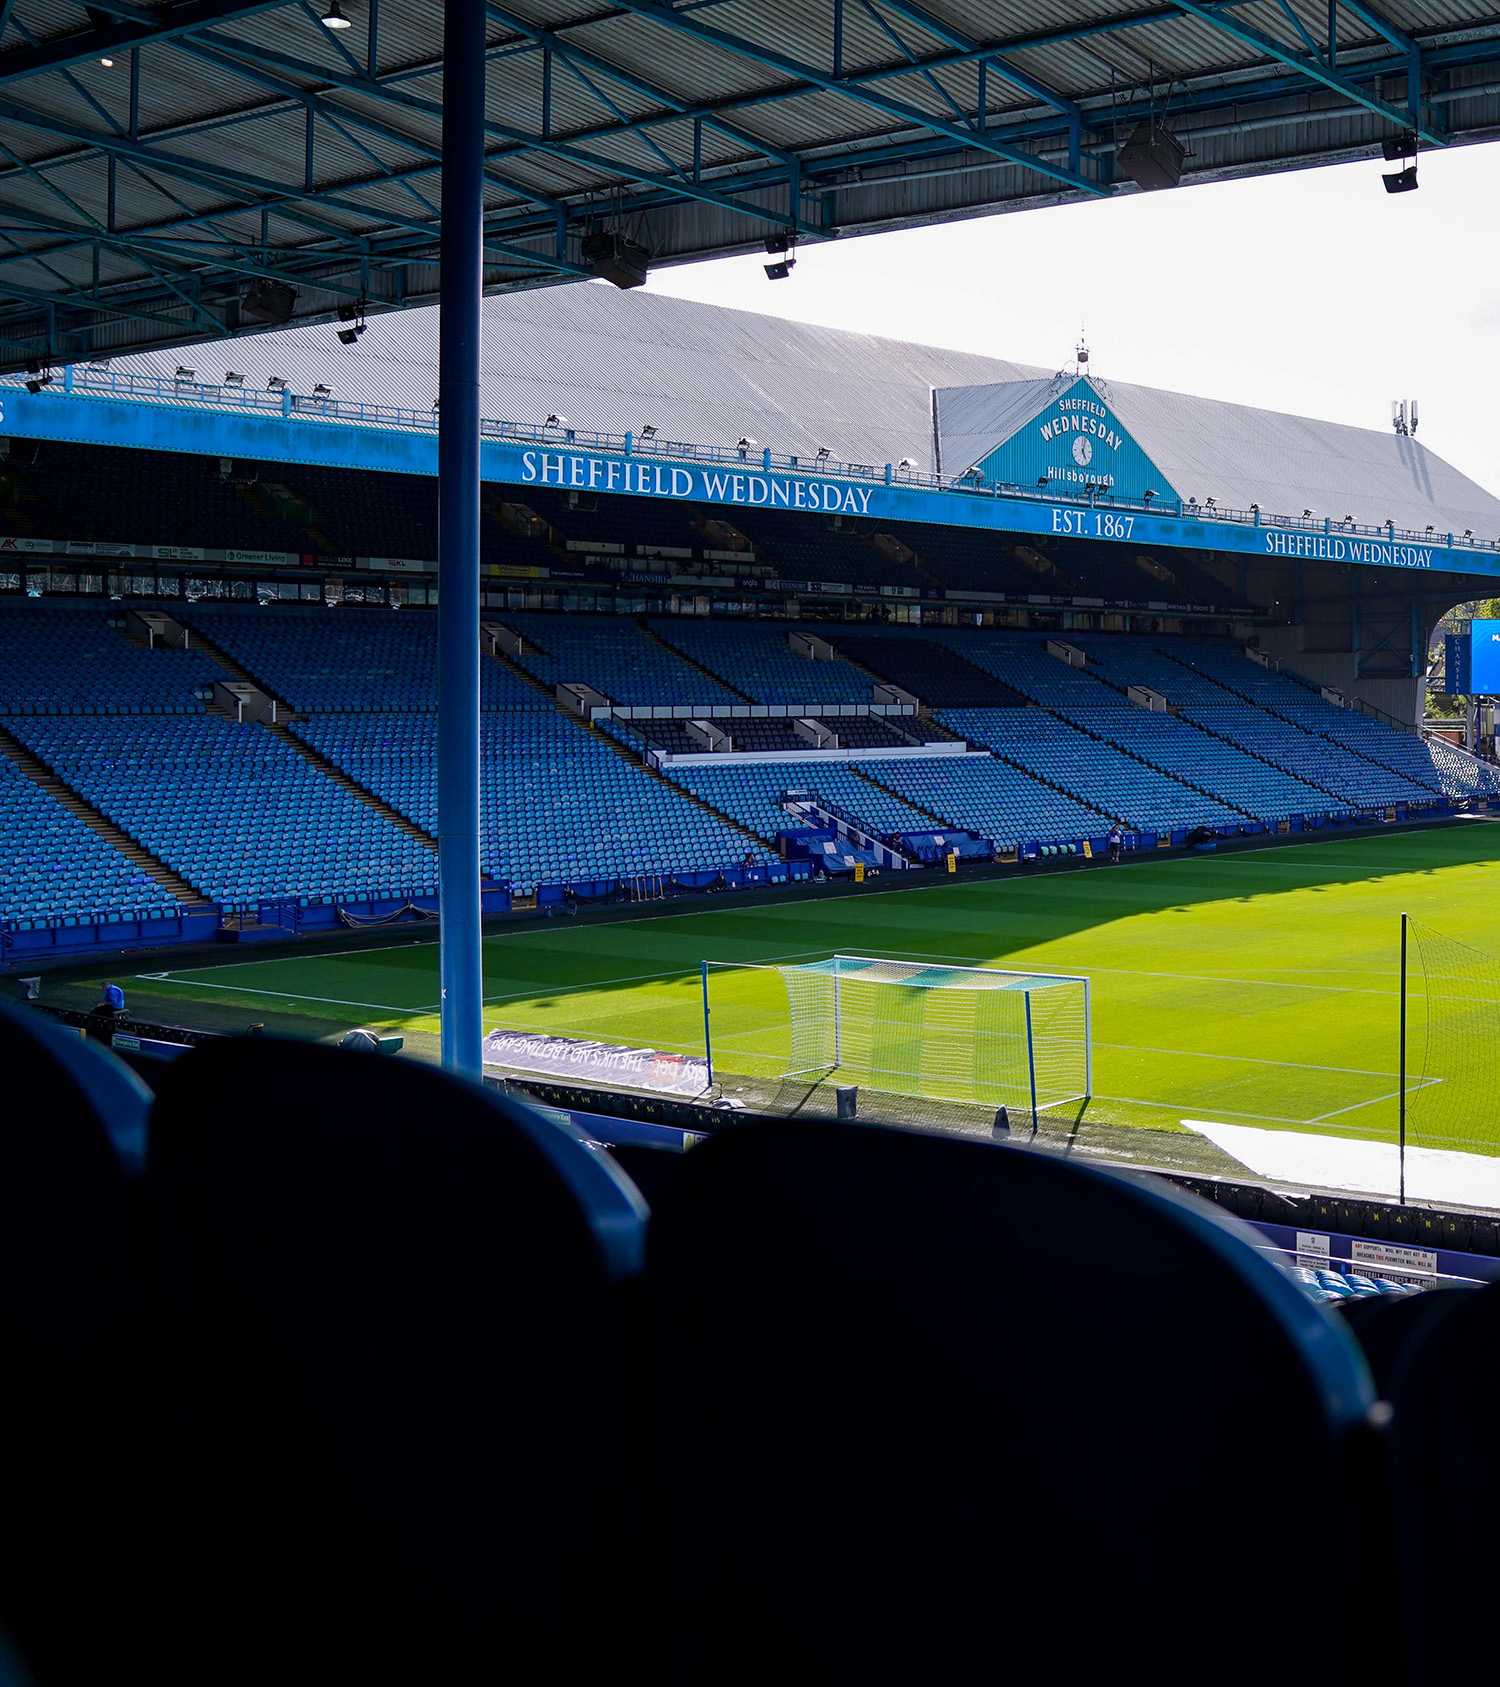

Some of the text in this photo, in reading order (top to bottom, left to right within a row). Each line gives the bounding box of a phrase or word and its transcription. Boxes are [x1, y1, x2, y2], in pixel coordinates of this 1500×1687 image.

[1059, 399, 1106, 418] SHEFFIELD
[1040, 415, 1123, 451] WEDNESDAY
[521, 452, 873, 515] SHEFFIELD WEDNESDAY
[1047, 466, 1114, 486] Hillsborough
[1052, 508, 1135, 541] EST. 1867
[236, 552, 285, 563] Greener Living
[1265, 532, 1433, 568] SHEFFIELD WEDNESDAY
[513, 1038, 561, 1060] BETTING
[618, 1054, 644, 1073] THE
[652, 1059, 678, 1083] bet
[681, 1059, 706, 1084] sky
[1450, 1223, 1456, 1231] 3
